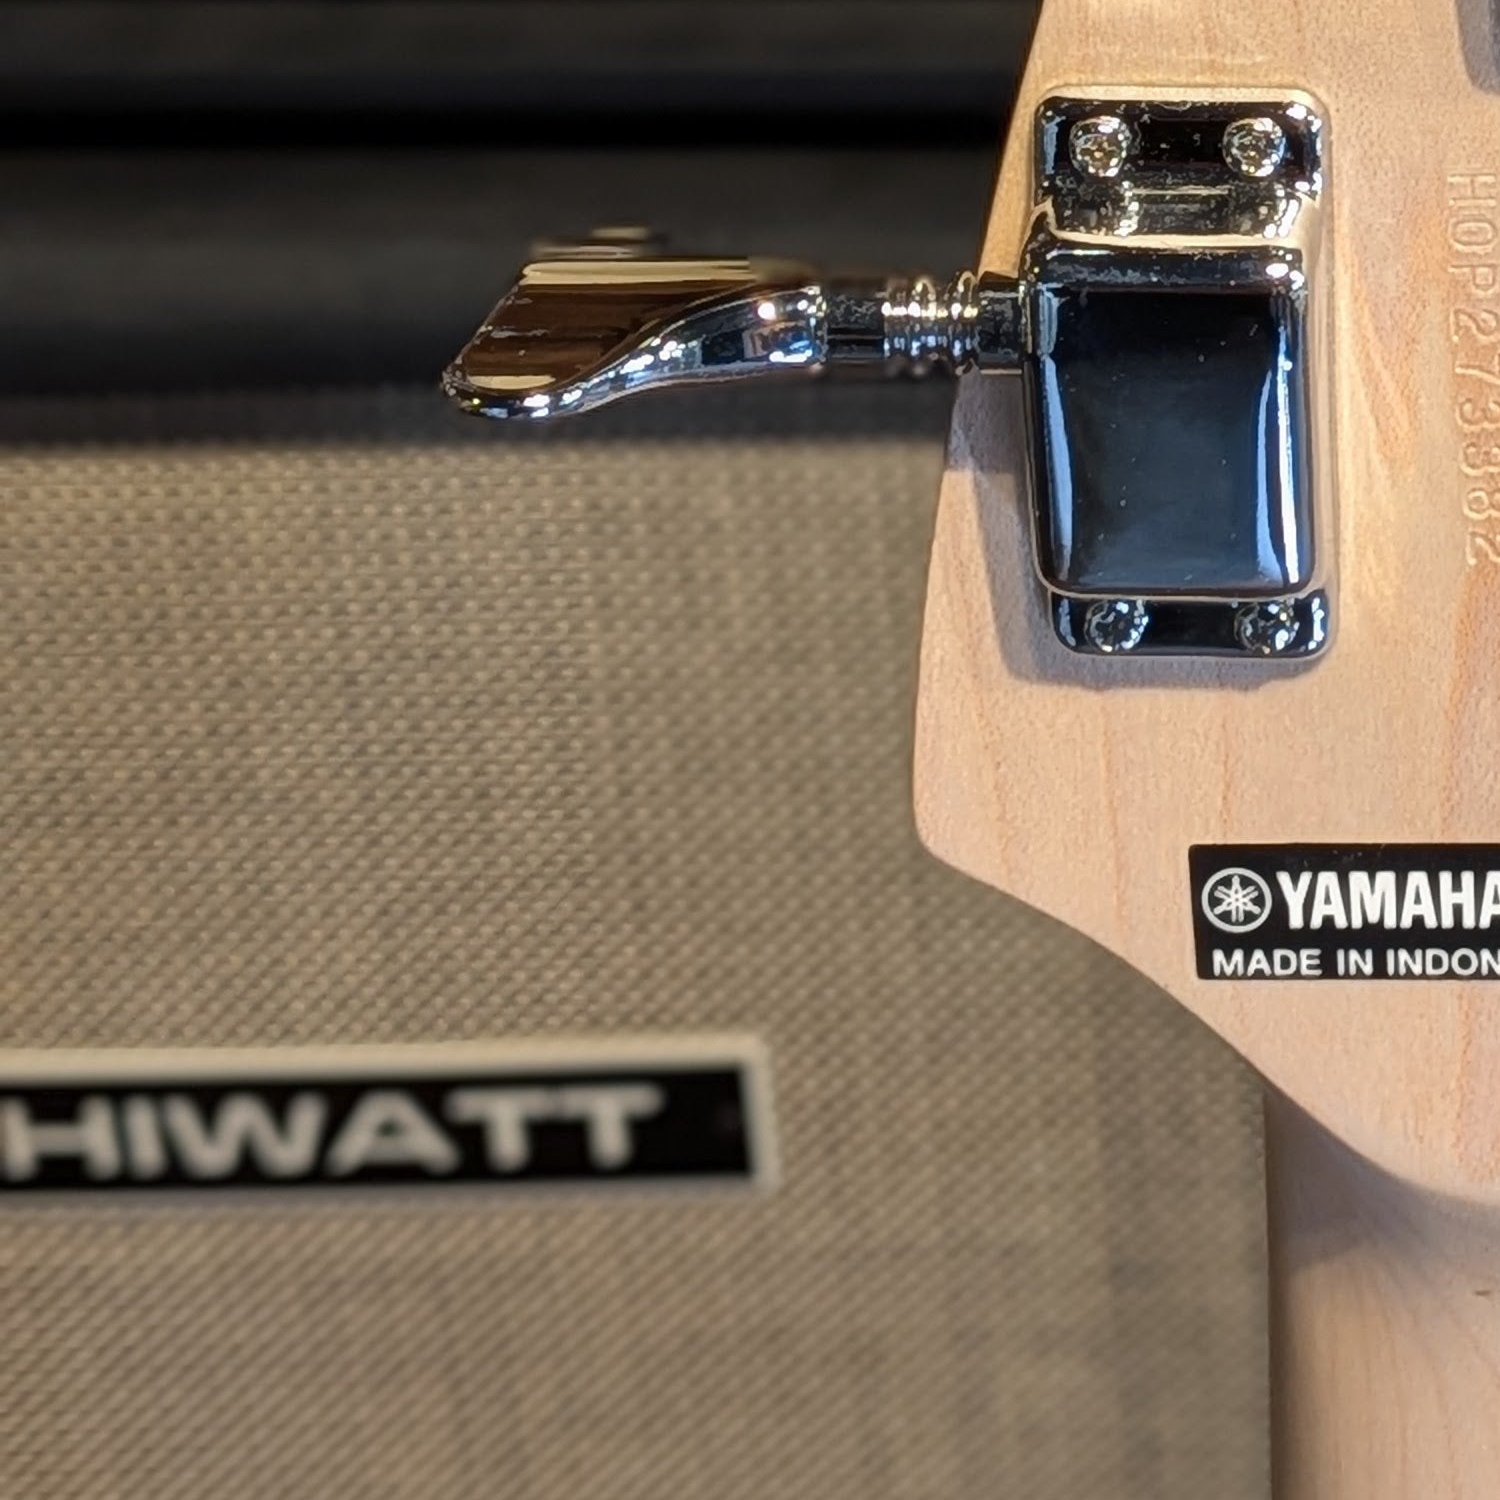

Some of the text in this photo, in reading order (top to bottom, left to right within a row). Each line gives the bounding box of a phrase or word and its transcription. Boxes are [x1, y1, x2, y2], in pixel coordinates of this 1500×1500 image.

[1212, 948, 1324, 977] MADE
[1336, 948, 1375, 977] IN
[0, 1085, 665, 1181] HIWATT
